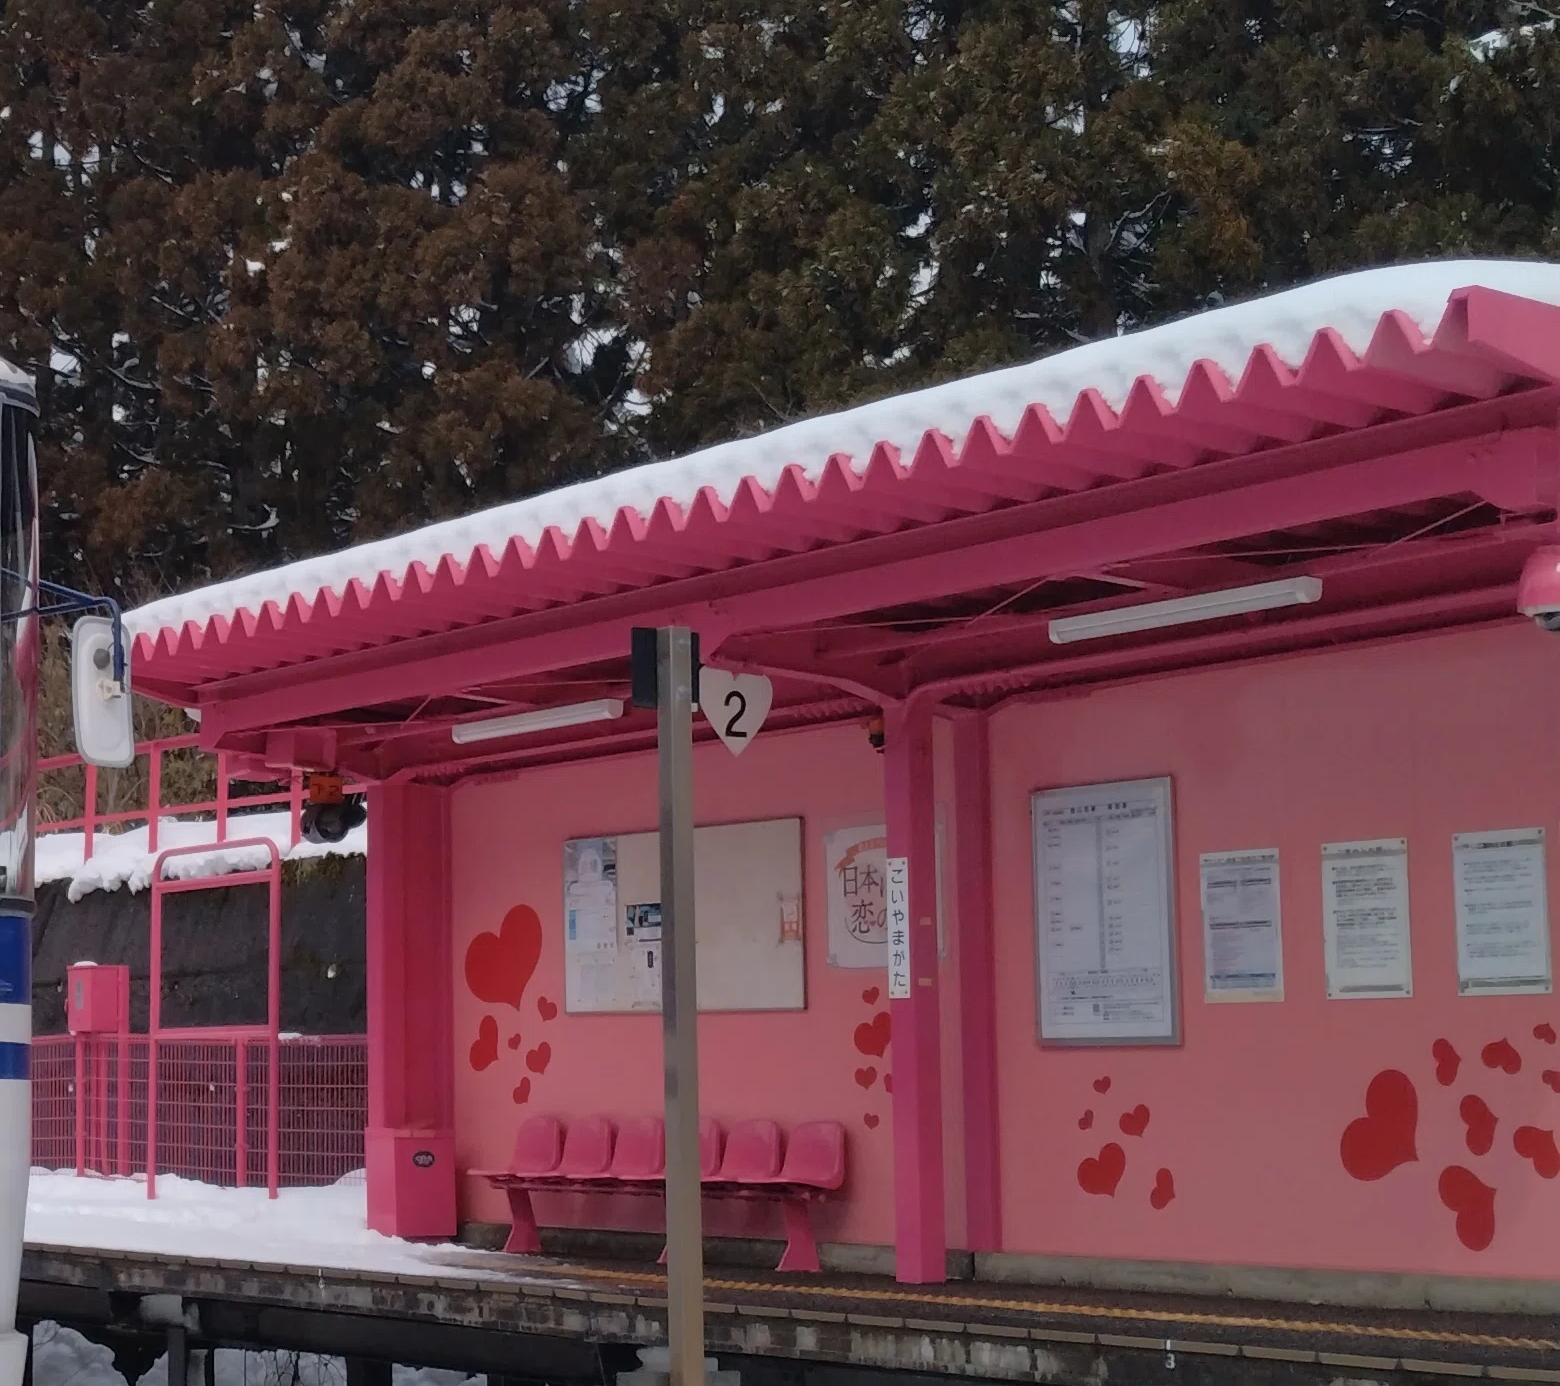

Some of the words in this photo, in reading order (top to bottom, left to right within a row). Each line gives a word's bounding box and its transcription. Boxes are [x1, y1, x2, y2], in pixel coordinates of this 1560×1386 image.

[724, 690, 748, 738] 2
[890, 868, 907, 988] こいやまがた
